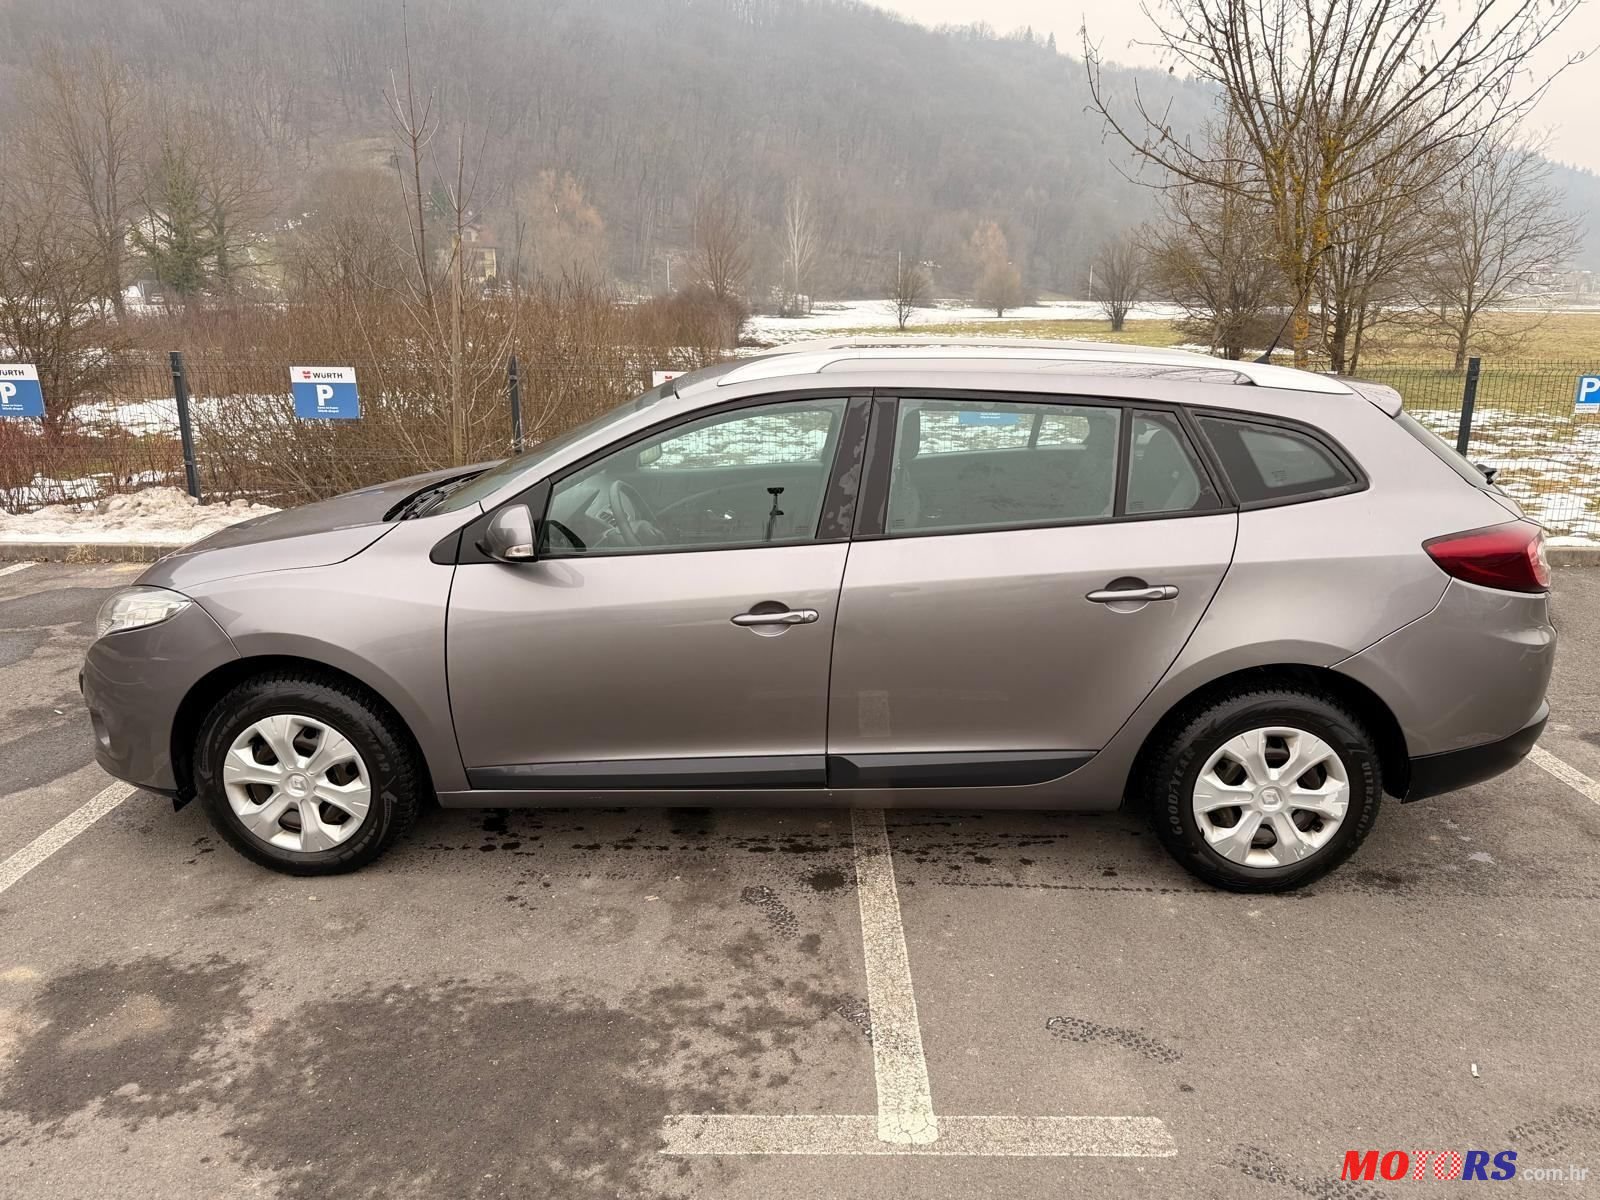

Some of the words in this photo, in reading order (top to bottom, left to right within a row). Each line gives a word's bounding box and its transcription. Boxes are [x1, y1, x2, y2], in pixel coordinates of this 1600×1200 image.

[0, 382, 17, 404] P
[316, 384, 334, 406] P
[1579, 377, 1600, 402] P
[1167, 748, 1197, 836] GOODYEAR
